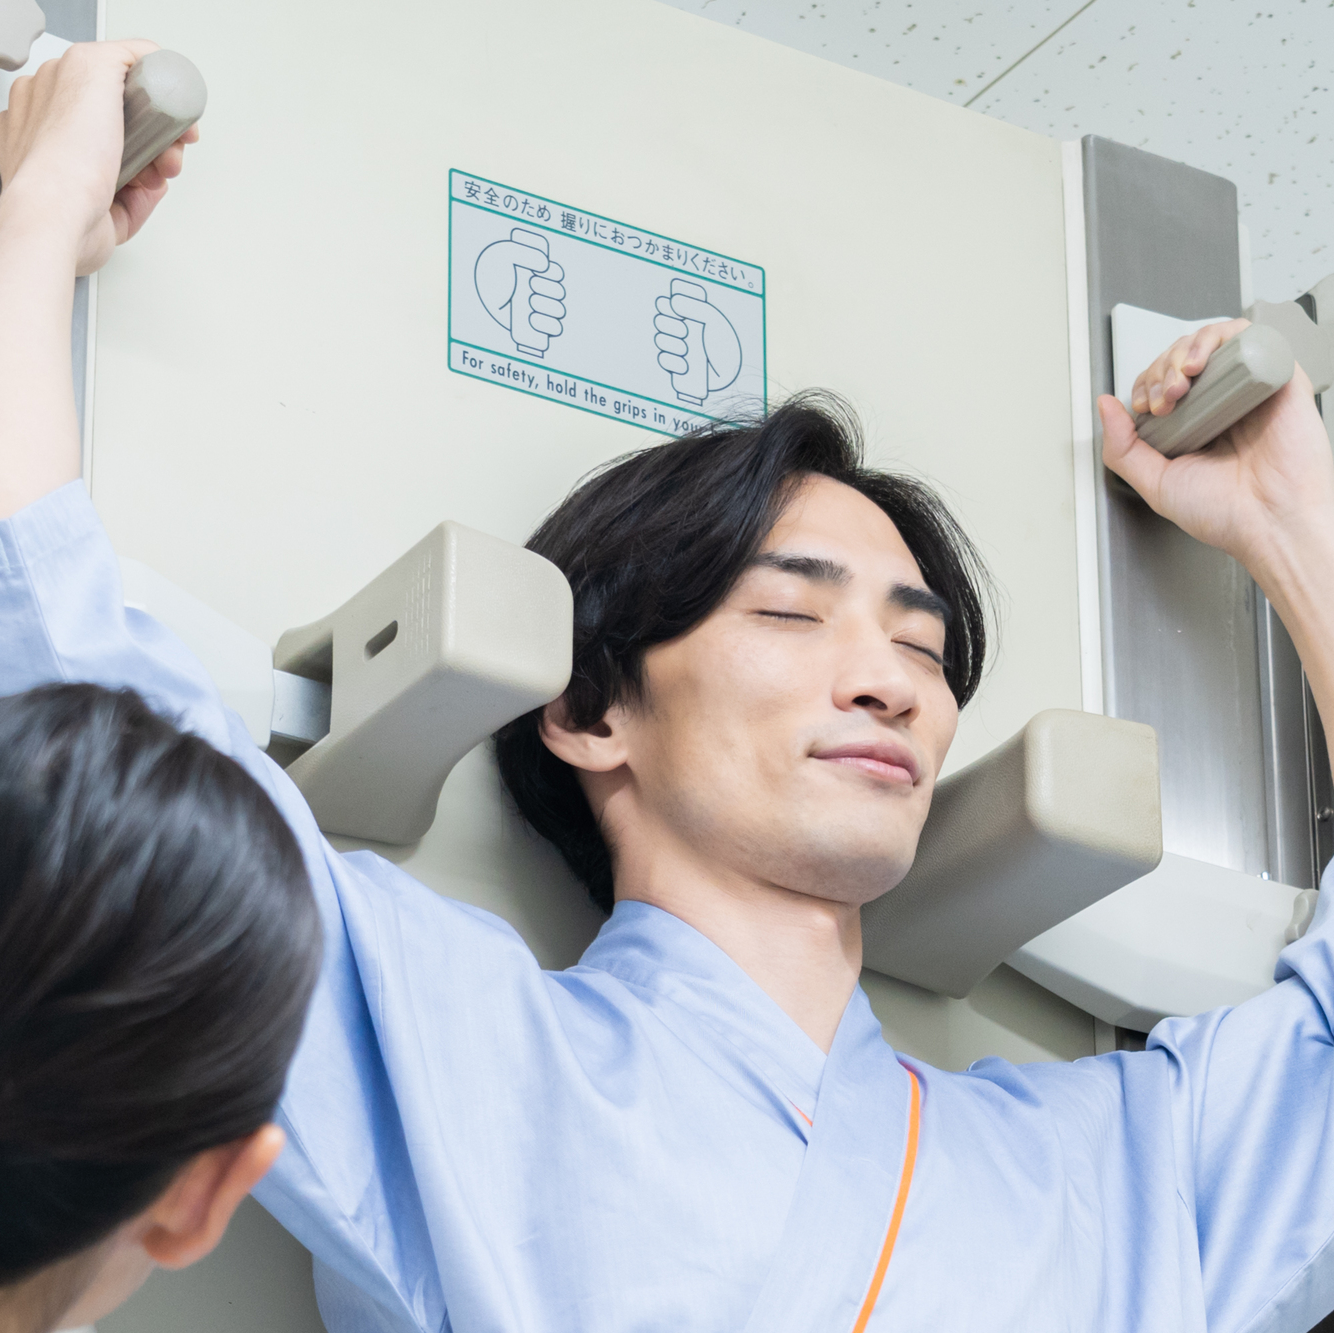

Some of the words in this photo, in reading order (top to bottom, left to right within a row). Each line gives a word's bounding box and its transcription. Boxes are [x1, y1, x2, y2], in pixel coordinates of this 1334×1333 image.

[464, 180, 551, 222] 安全のため
[560, 214, 755, 289] 握りにおつかまりください。
[462, 350, 484, 370] For
[491, 363, 539, 390] safety,
[547, 374, 576, 398] hold
[584, 387, 607, 407] the
[613, 400, 647, 420] grips
[653, 407, 666, 425] in
